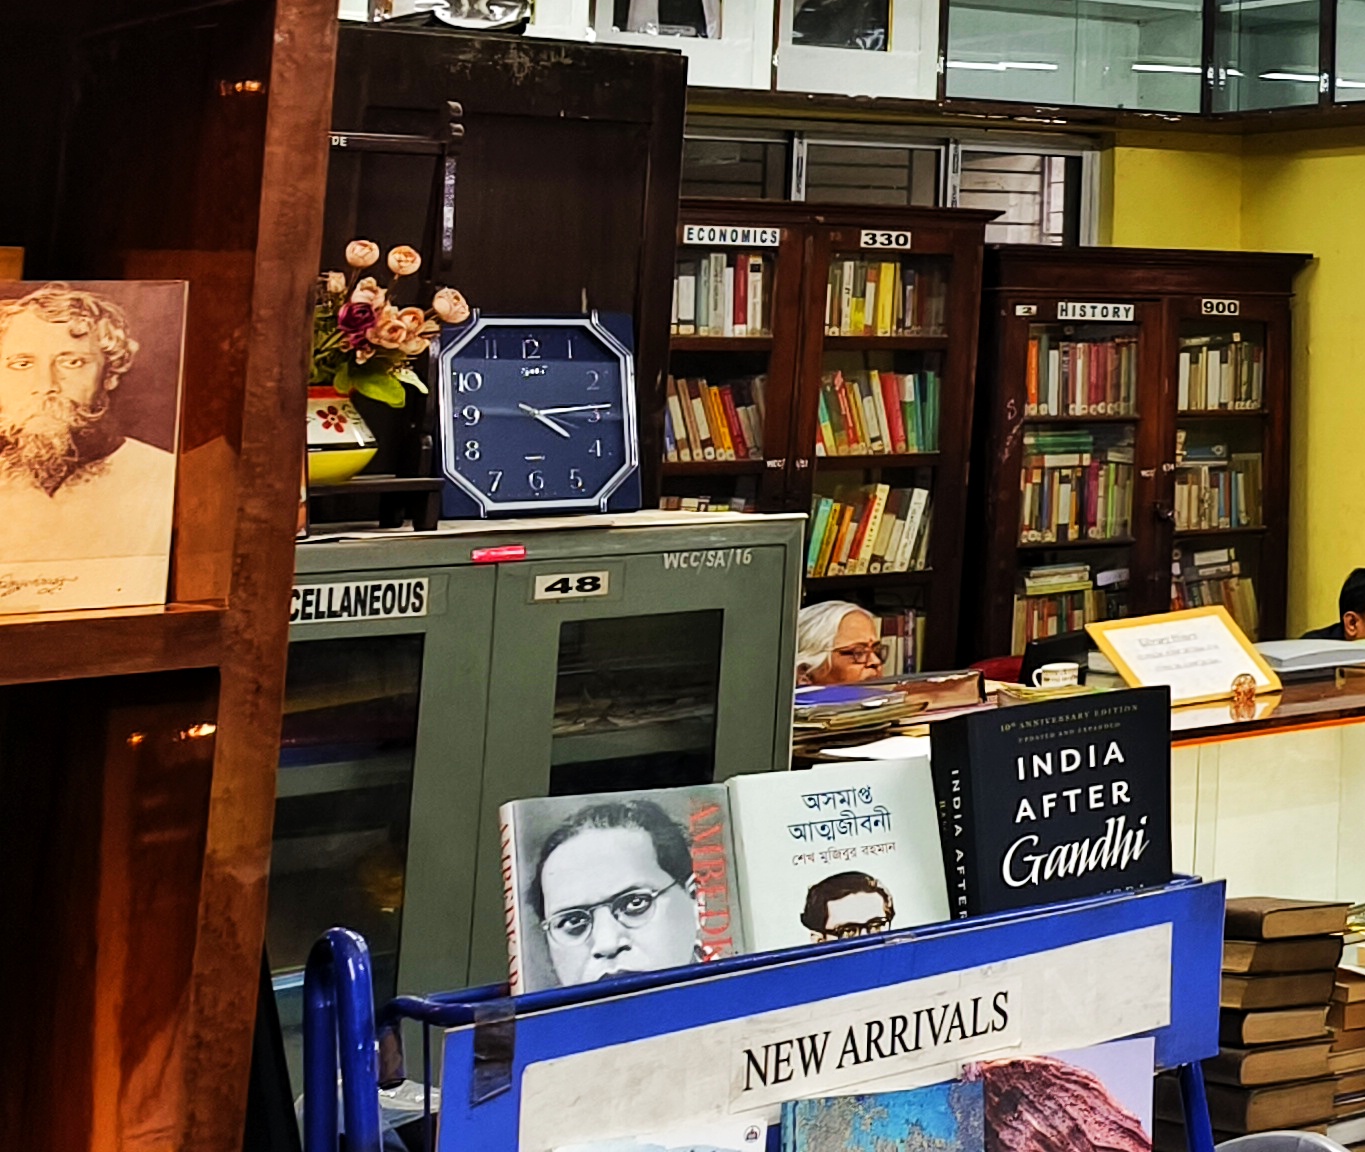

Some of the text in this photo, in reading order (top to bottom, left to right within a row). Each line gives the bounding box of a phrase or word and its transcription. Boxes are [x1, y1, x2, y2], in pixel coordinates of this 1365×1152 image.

[687, 227, 777, 244] ECONOMICS
[863, 233, 909, 246] 330
[1060, 304, 1132, 318] HISTORY
[1203, 301, 1238, 313] 900
[522, 339, 540, 359] 12
[568, 339, 572, 359] 1
[458, 371, 482, 392] 10
[586, 370, 600, 391] 2
[463, 405, 481, 426] 9
[465, 440, 480, 460] 8
[588, 440, 601, 457] 4
[488, 470, 503, 492] 7
[528, 470, 544, 490] 6
[570, 469, 583, 489] 5
[662, 550, 752, 575] WCC/SA/16
[544, 575, 602, 594] 48
[1018, 704, 1138, 729] ANNIVERSARY EDITION
[1058, 727, 1075, 736] AND
[1017, 741, 1125, 780] INDIA
[801, 785, 873, 812] অসমাপ্ত
[1015, 780, 1131, 823] AFTER
[787, 807, 892, 843] আত্মজীবনী
[792, 841, 896, 866] শেখ মুজিবুর রহমান
[951, 769, 967, 919] INDIA AFTER
[1002, 815, 1150, 887] Gandhi
[742, 990, 1009, 1092] NEW ARRIVALS
